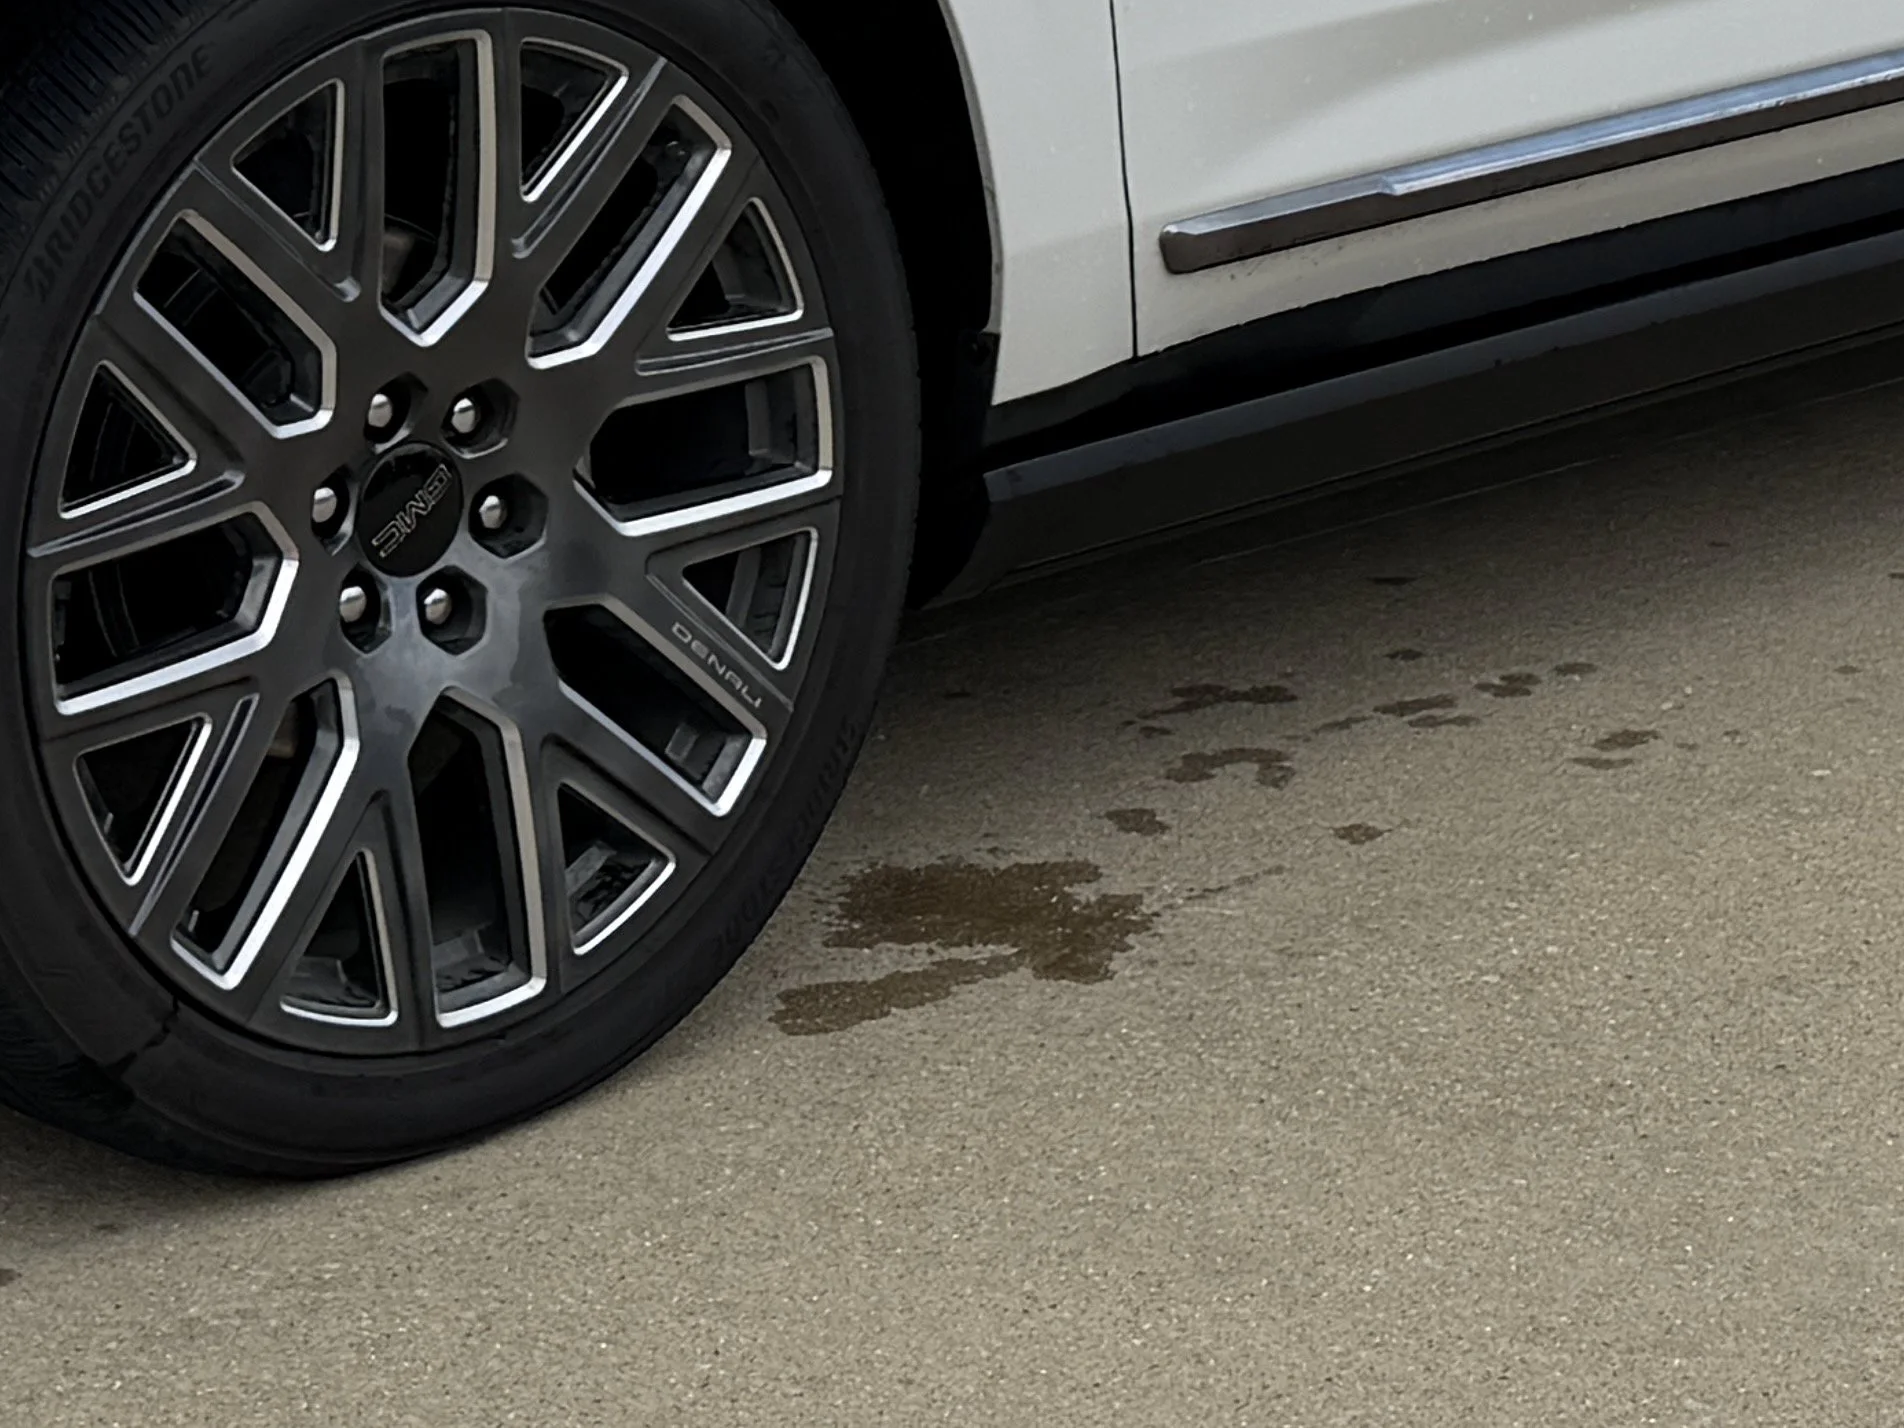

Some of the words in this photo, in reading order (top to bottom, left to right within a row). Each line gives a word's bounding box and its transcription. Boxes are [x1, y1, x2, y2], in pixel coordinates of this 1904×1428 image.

[22, 43, 213, 302] BRIDGESTONE
[371, 463, 453, 558] GMC
[672, 622, 762, 708] DENALI
